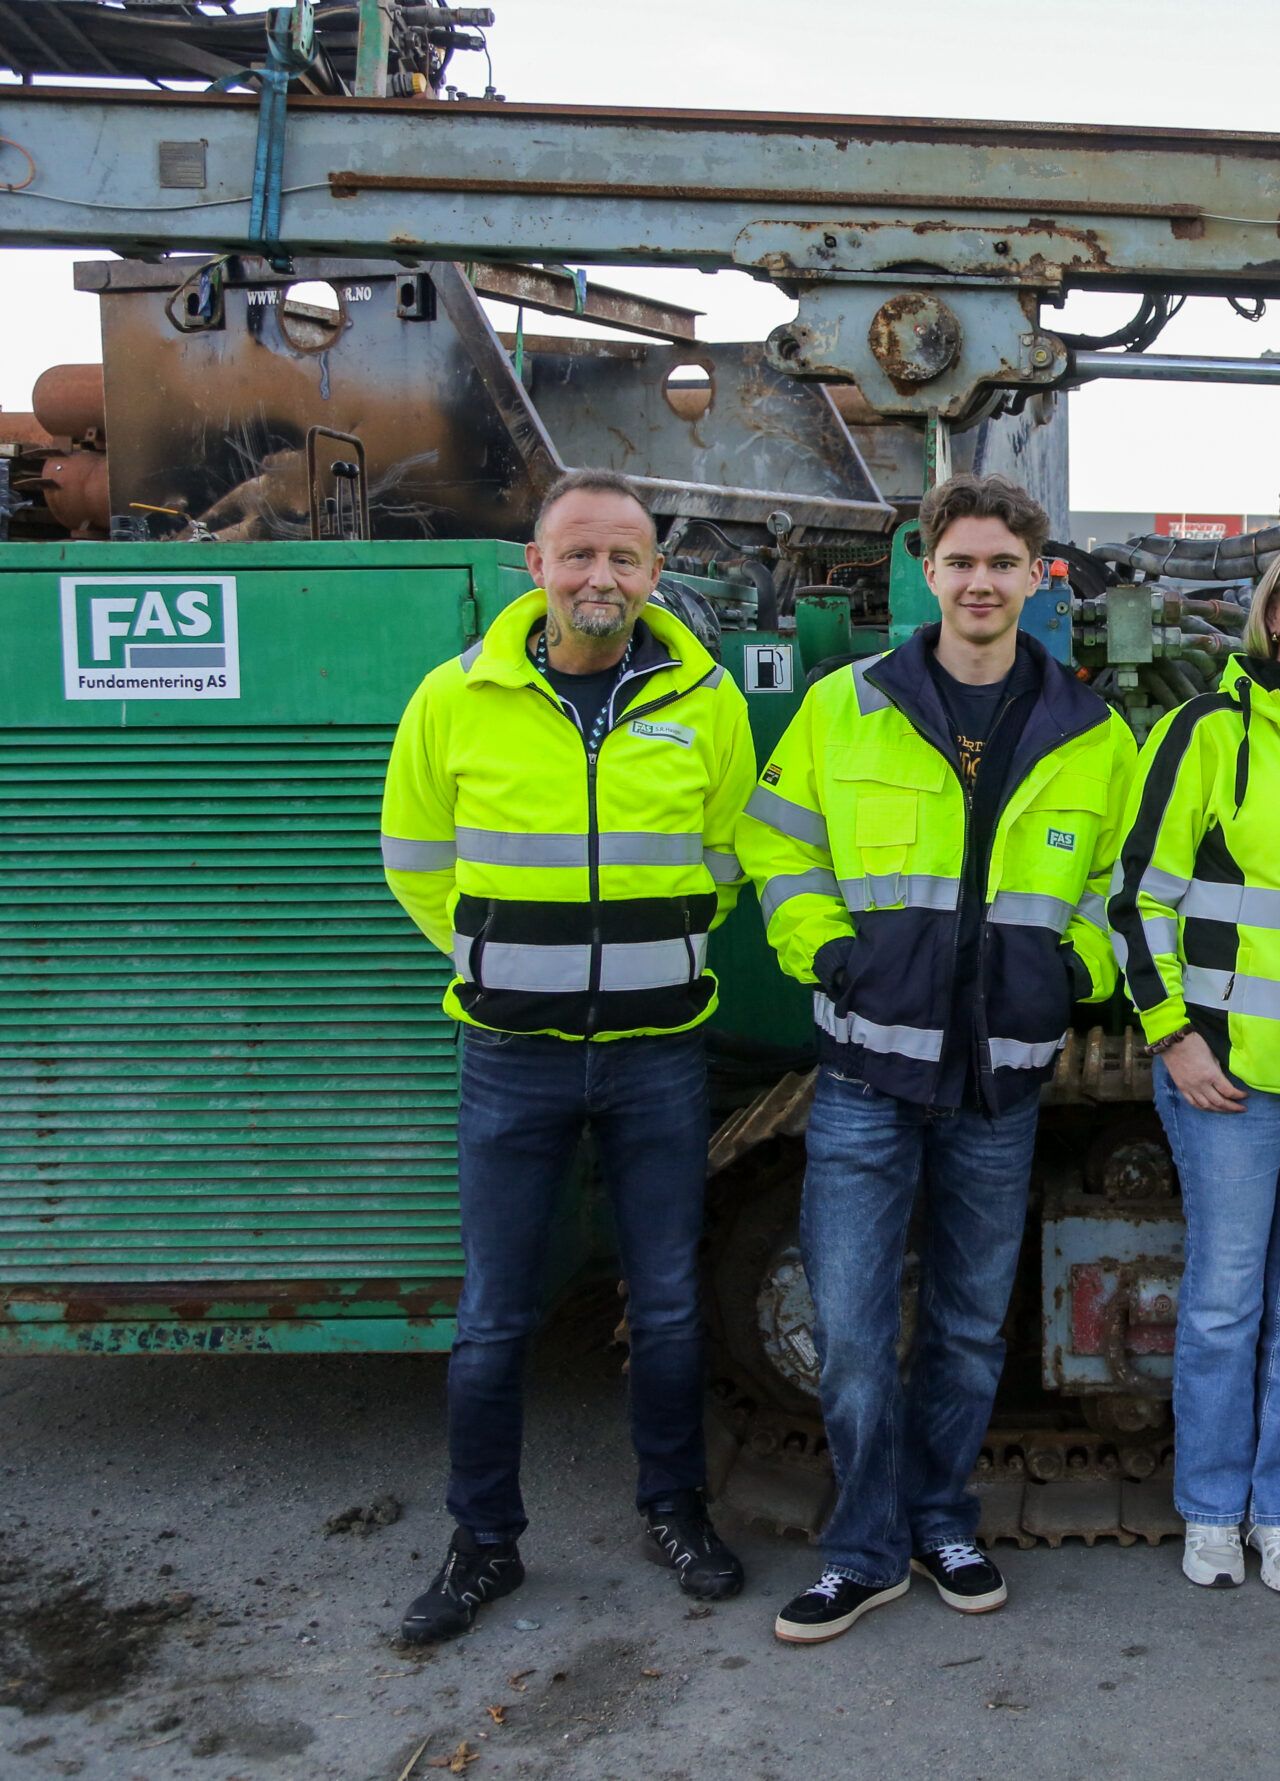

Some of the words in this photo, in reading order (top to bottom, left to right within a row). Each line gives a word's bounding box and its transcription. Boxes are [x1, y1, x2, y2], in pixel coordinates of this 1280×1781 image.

[246, 290, 282, 306] WWW.
[91, 590, 212, 661] FAS
[79, 675, 203, 691] Fundamentering
[206, 675, 227, 688] AS
[634, 722, 652, 733] FAS
[1050, 831, 1072, 845] FAS
